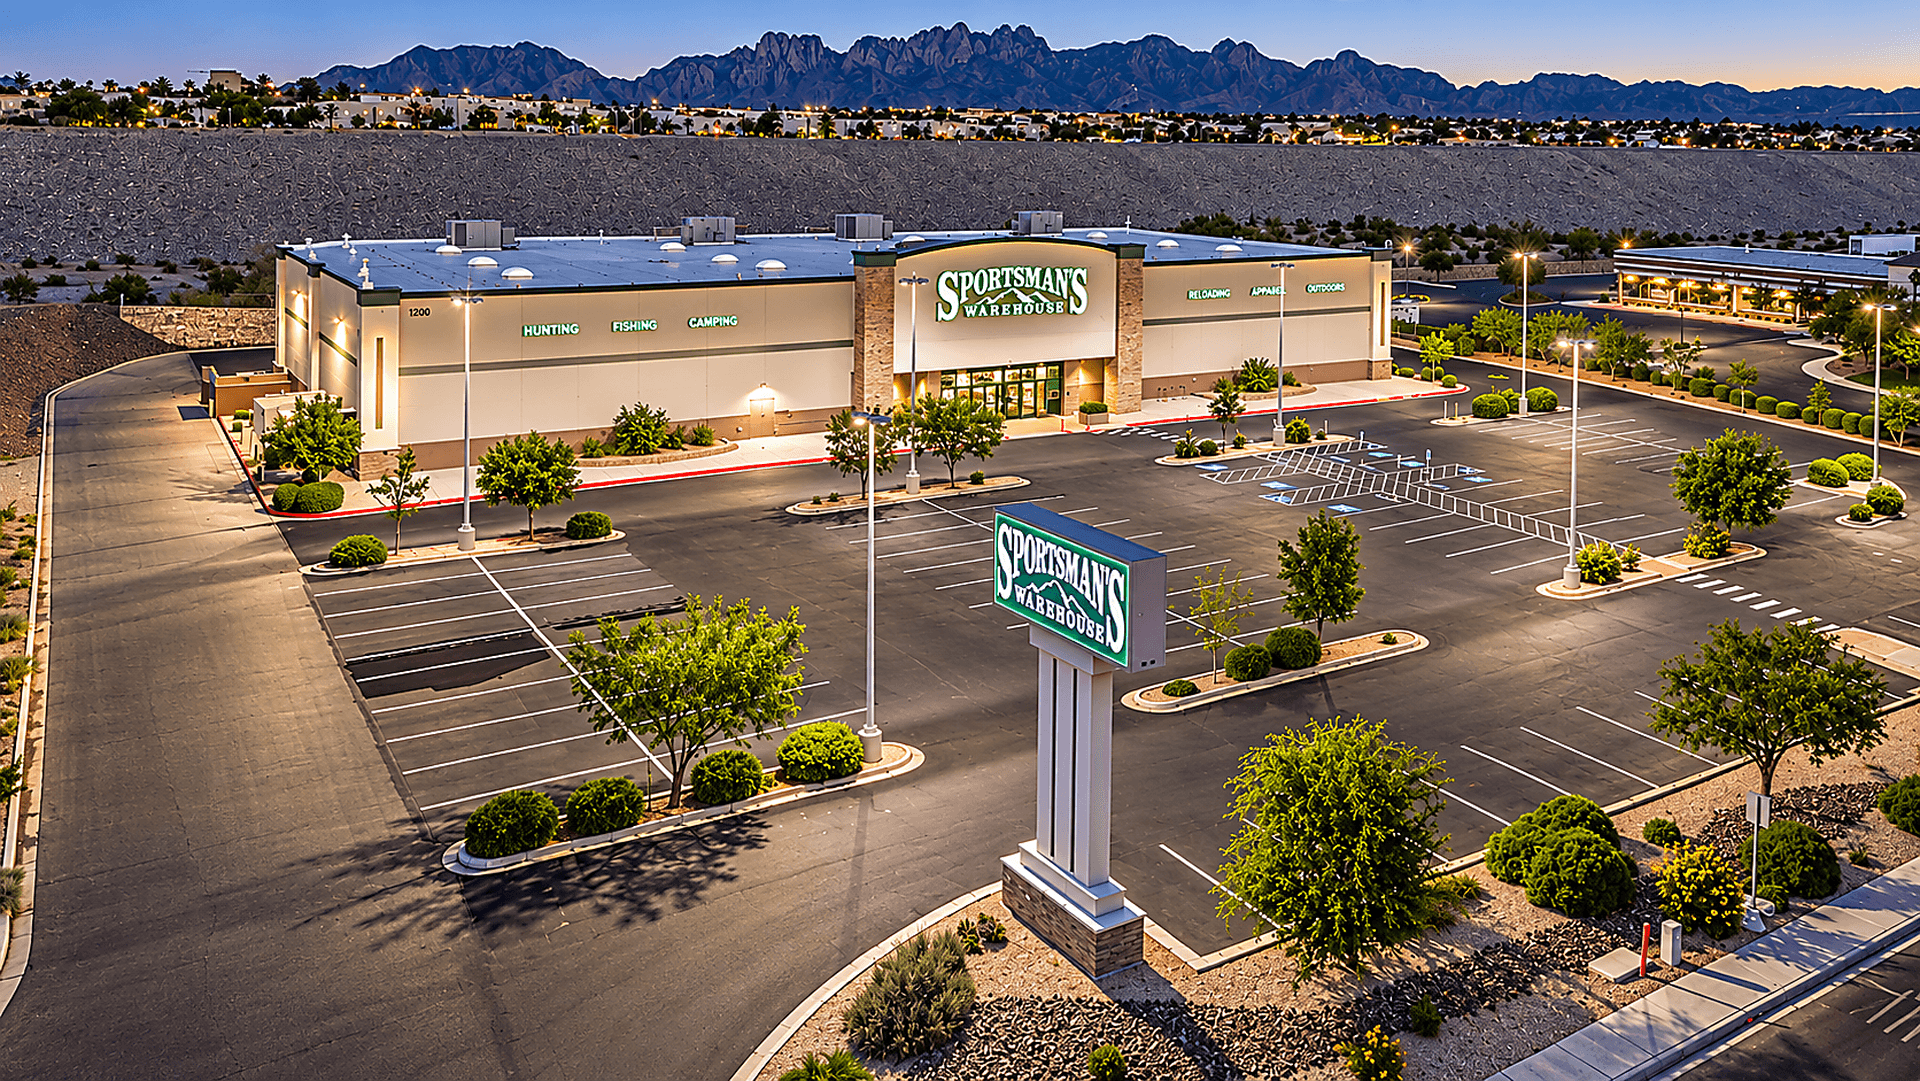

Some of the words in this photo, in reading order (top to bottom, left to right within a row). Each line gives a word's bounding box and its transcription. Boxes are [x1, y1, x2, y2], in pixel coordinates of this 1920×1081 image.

[936, 266, 1088, 322] SPORTSMAN'S
[1187, 289, 1231, 300] RELOADING
[1306, 283, 1346, 293] OUTDOORS
[408, 307, 431, 317] 1200
[963, 302, 1064, 317] WAREHOUSE
[522, 323, 579, 337] HUNTING
[612, 319, 658, 332] FISHING
[688, 315, 738, 328] CAMPING
[997, 523, 1125, 653] SPORTSMAN'S
[1014, 584, 1105, 645] WAREHOUSE
